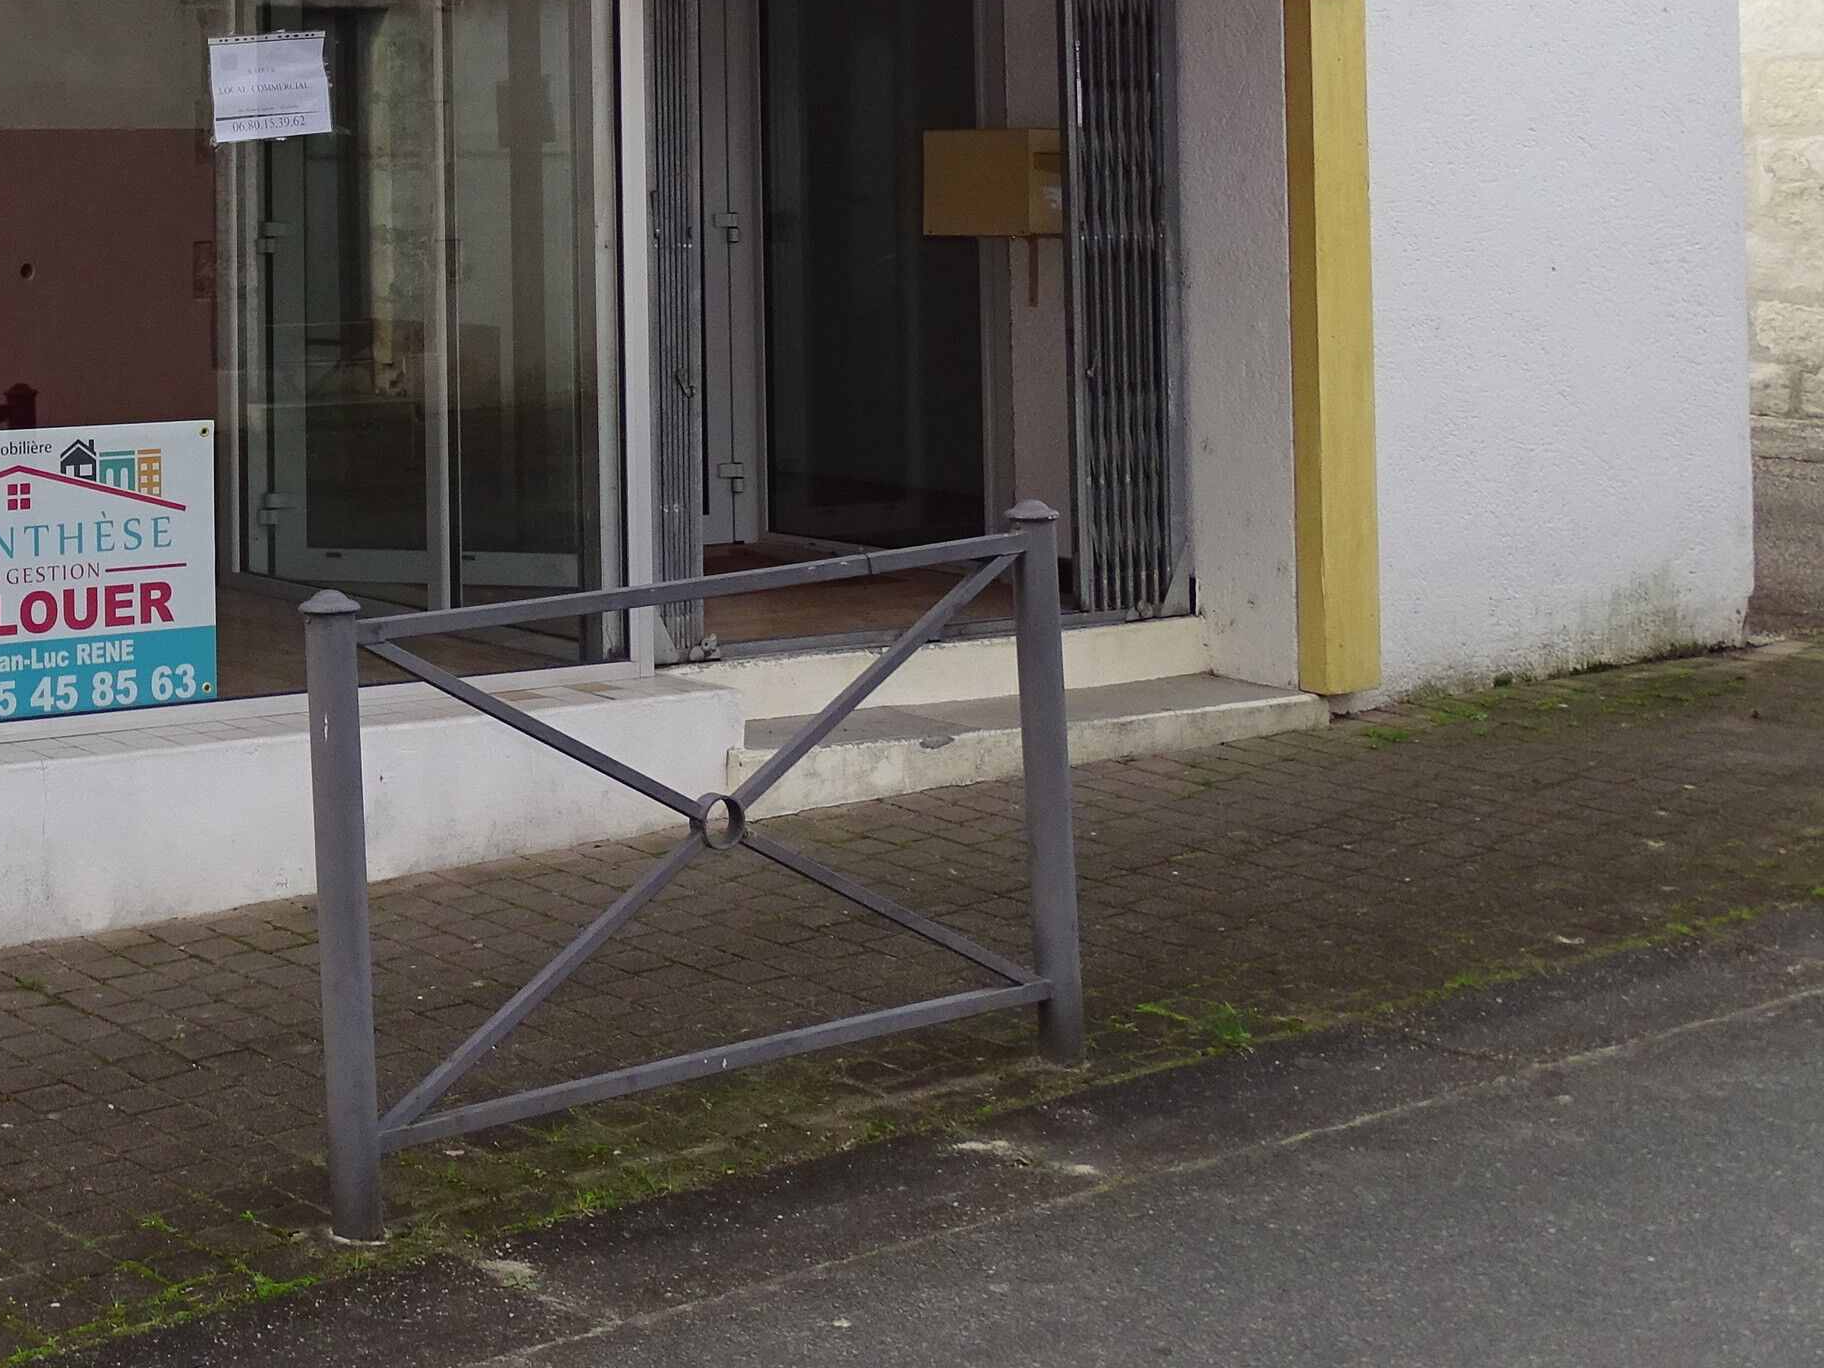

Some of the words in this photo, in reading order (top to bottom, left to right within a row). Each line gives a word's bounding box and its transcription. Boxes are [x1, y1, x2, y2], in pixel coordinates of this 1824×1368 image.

[219, 87, 247, 95] LOCAL
[251, 82, 309, 93] COMMERCIAL
[232, 115, 306, 131] 06.80.15.39.62
[6, 562, 101, 585] GESTION
[76, 639, 135, 666] RENE
[30, 675, 78, 712] 45
[91, 669, 138, 707] 85
[151, 663, 197, 699] 63
